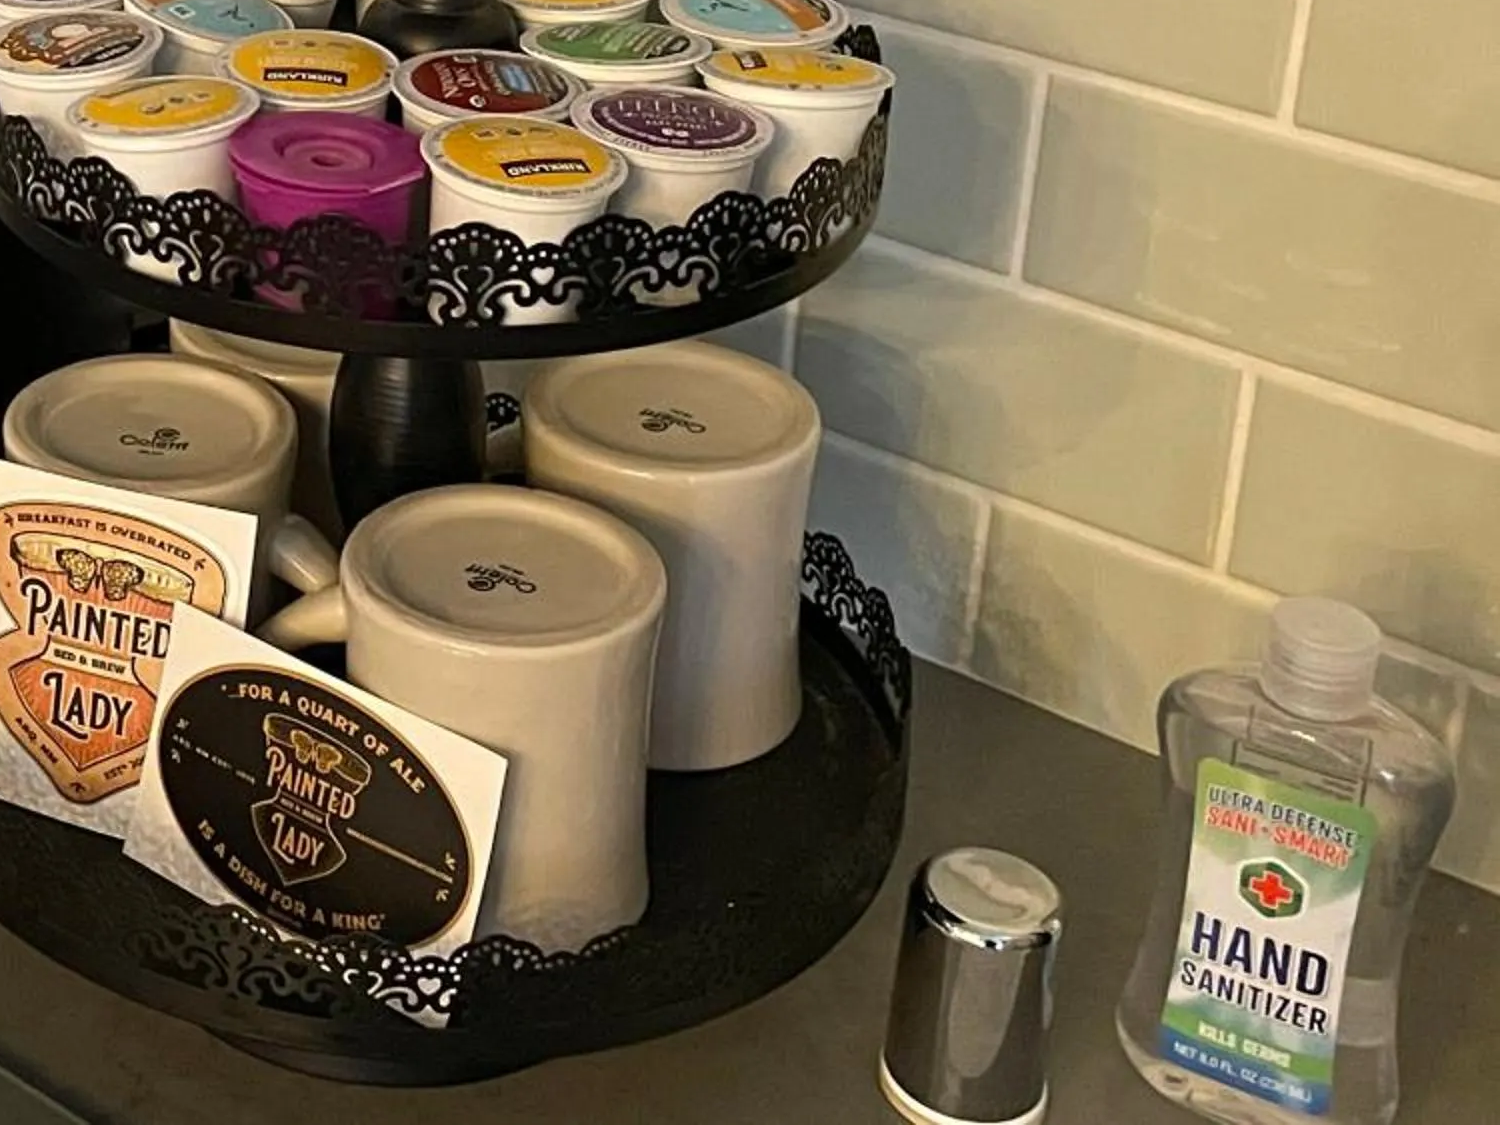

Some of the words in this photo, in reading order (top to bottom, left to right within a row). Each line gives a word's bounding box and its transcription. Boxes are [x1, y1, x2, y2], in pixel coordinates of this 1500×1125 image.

[17, 511, 92, 530] BREAKFAST
[95, 521, 107, 532] IS
[110, 525, 192, 561] OVERRATED
[20, 577, 172, 659] PAINTED
[91, 658, 127, 675] BREW
[43, 671, 133, 740] LADY
[238, 683, 274, 702] FOR
[278, 690, 292, 706] A
[297, 696, 360, 737] QUART
[363, 733, 389, 758] OF
[389, 757, 426, 795] ALE
[265, 746, 356, 820] PAINTED
[1208, 785, 1265, 816] ULTRA
[1270, 803, 1357, 849] DEFENSE
[197, 818, 217, 841] IS
[213, 842, 227, 859] A
[227, 854, 269, 897] DISH
[269, 887, 308, 918] FOR
[311, 906, 327, 925] A
[270, 812, 325, 867] LADY
[1190, 910, 1329, 997] HAND
[1180, 959, 1328, 1035] SANITIZER
